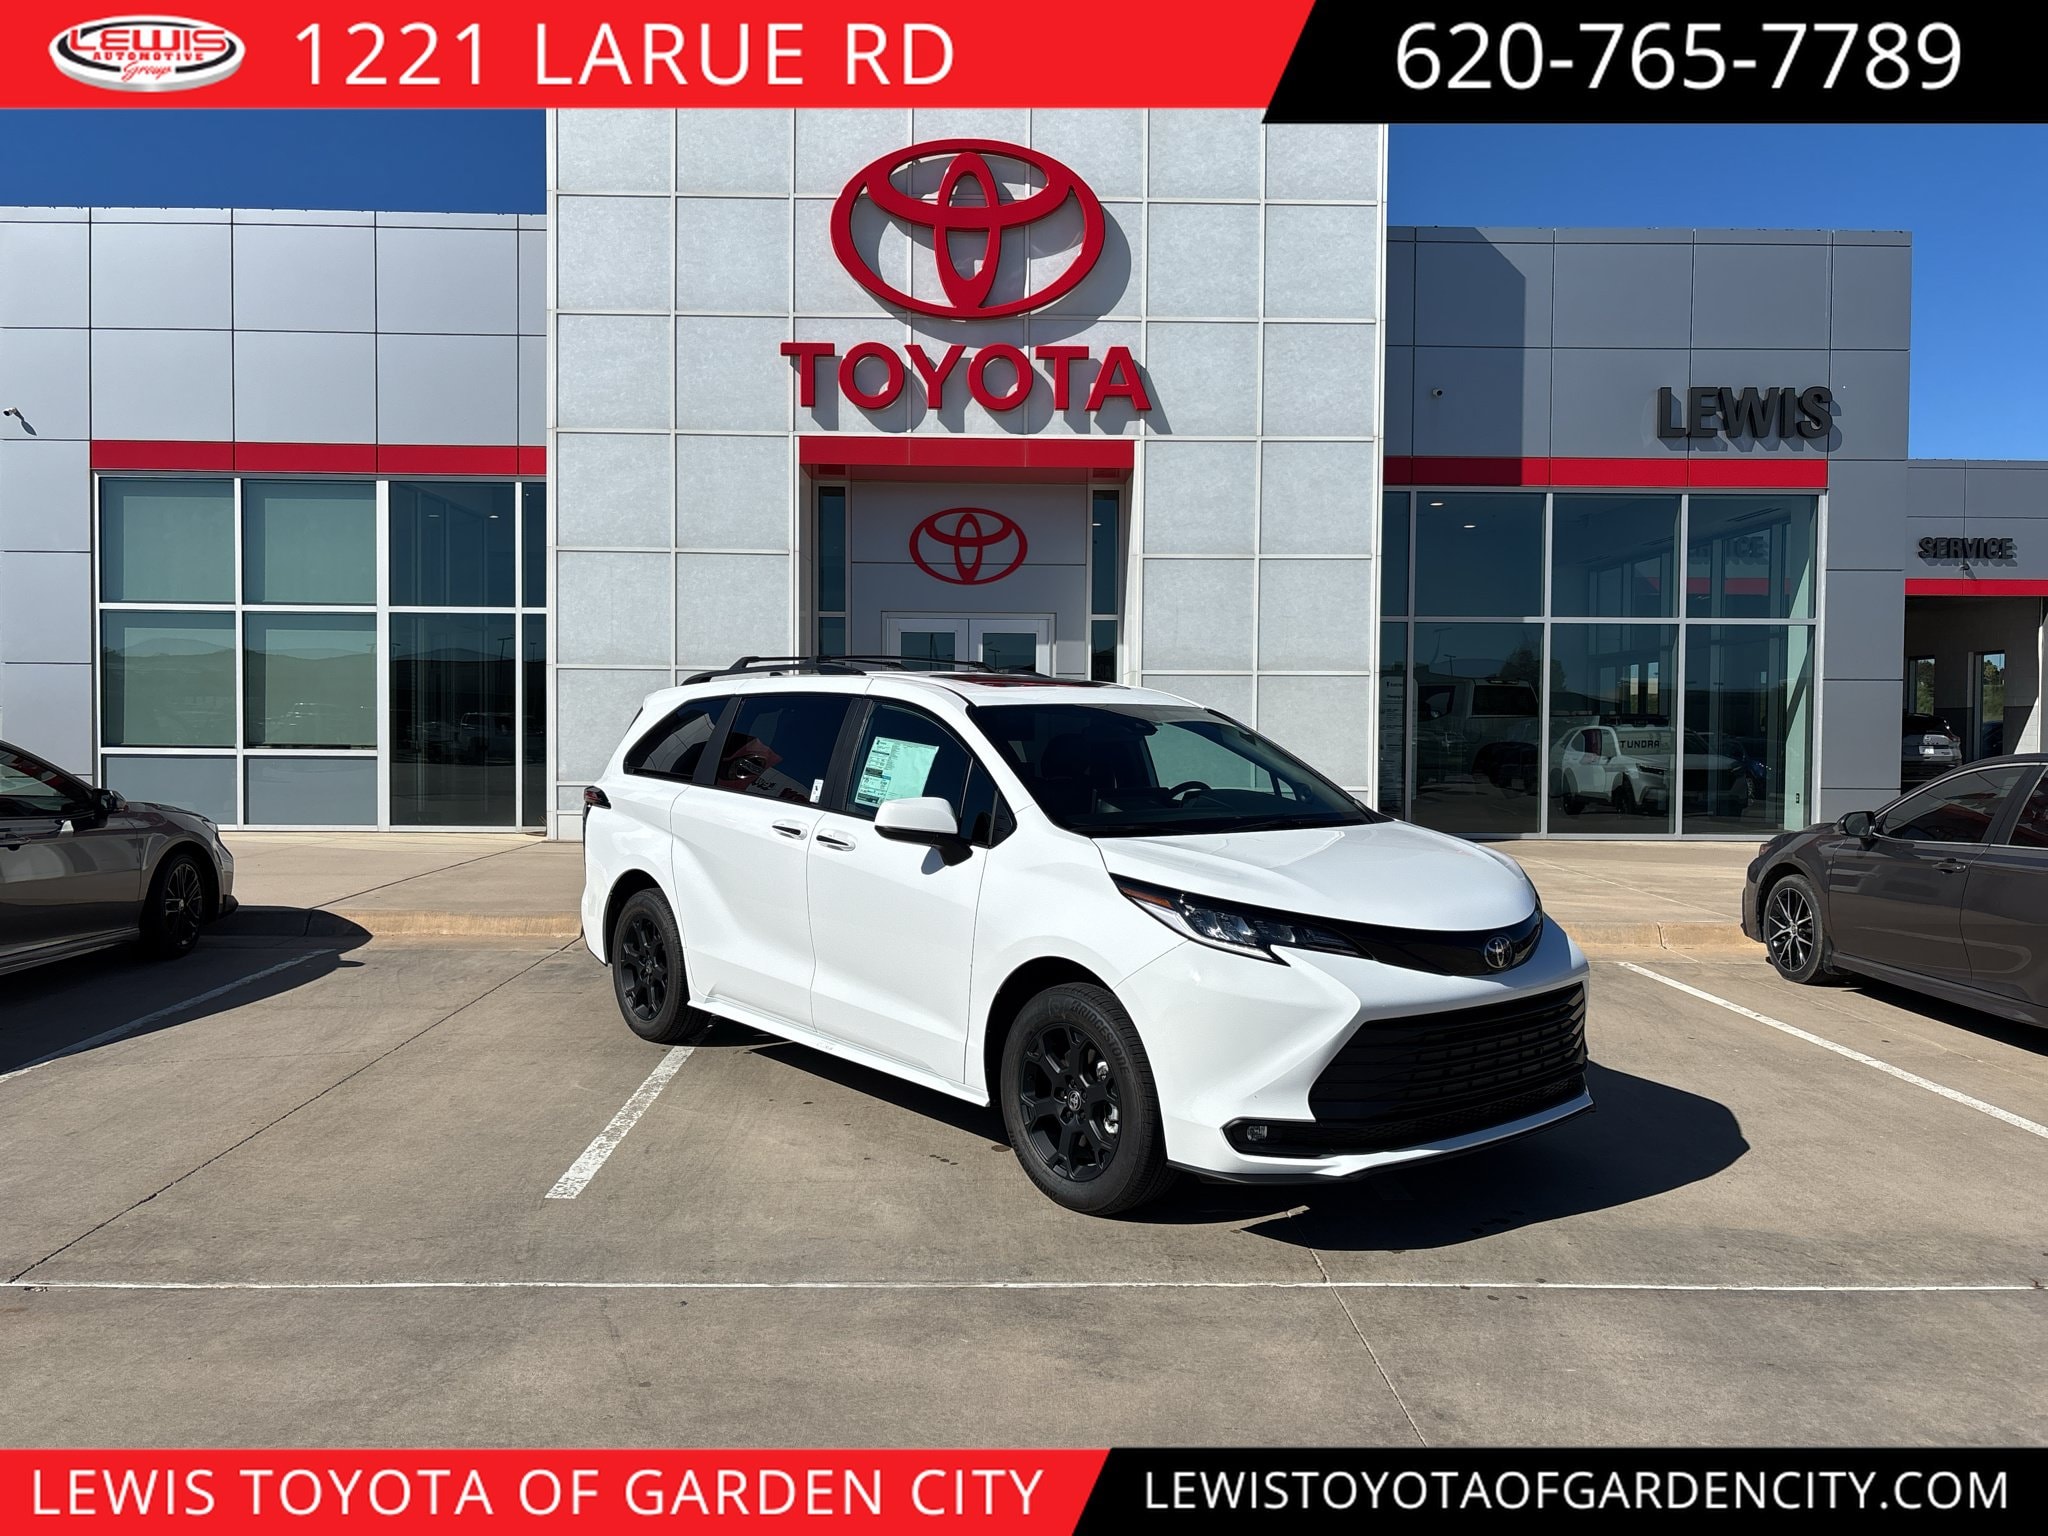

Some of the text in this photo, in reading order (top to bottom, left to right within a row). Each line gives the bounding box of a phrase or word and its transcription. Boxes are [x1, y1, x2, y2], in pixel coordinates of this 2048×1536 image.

[780, 341, 1153, 412] TOYOTA
[1657, 385, 1835, 439] LEWIS
[1918, 536, 2014, 560] SERVICE
[1619, 739, 1660, 749] TUNDRA
[1071, 999, 1130, 1075] BRIDGESTONE
